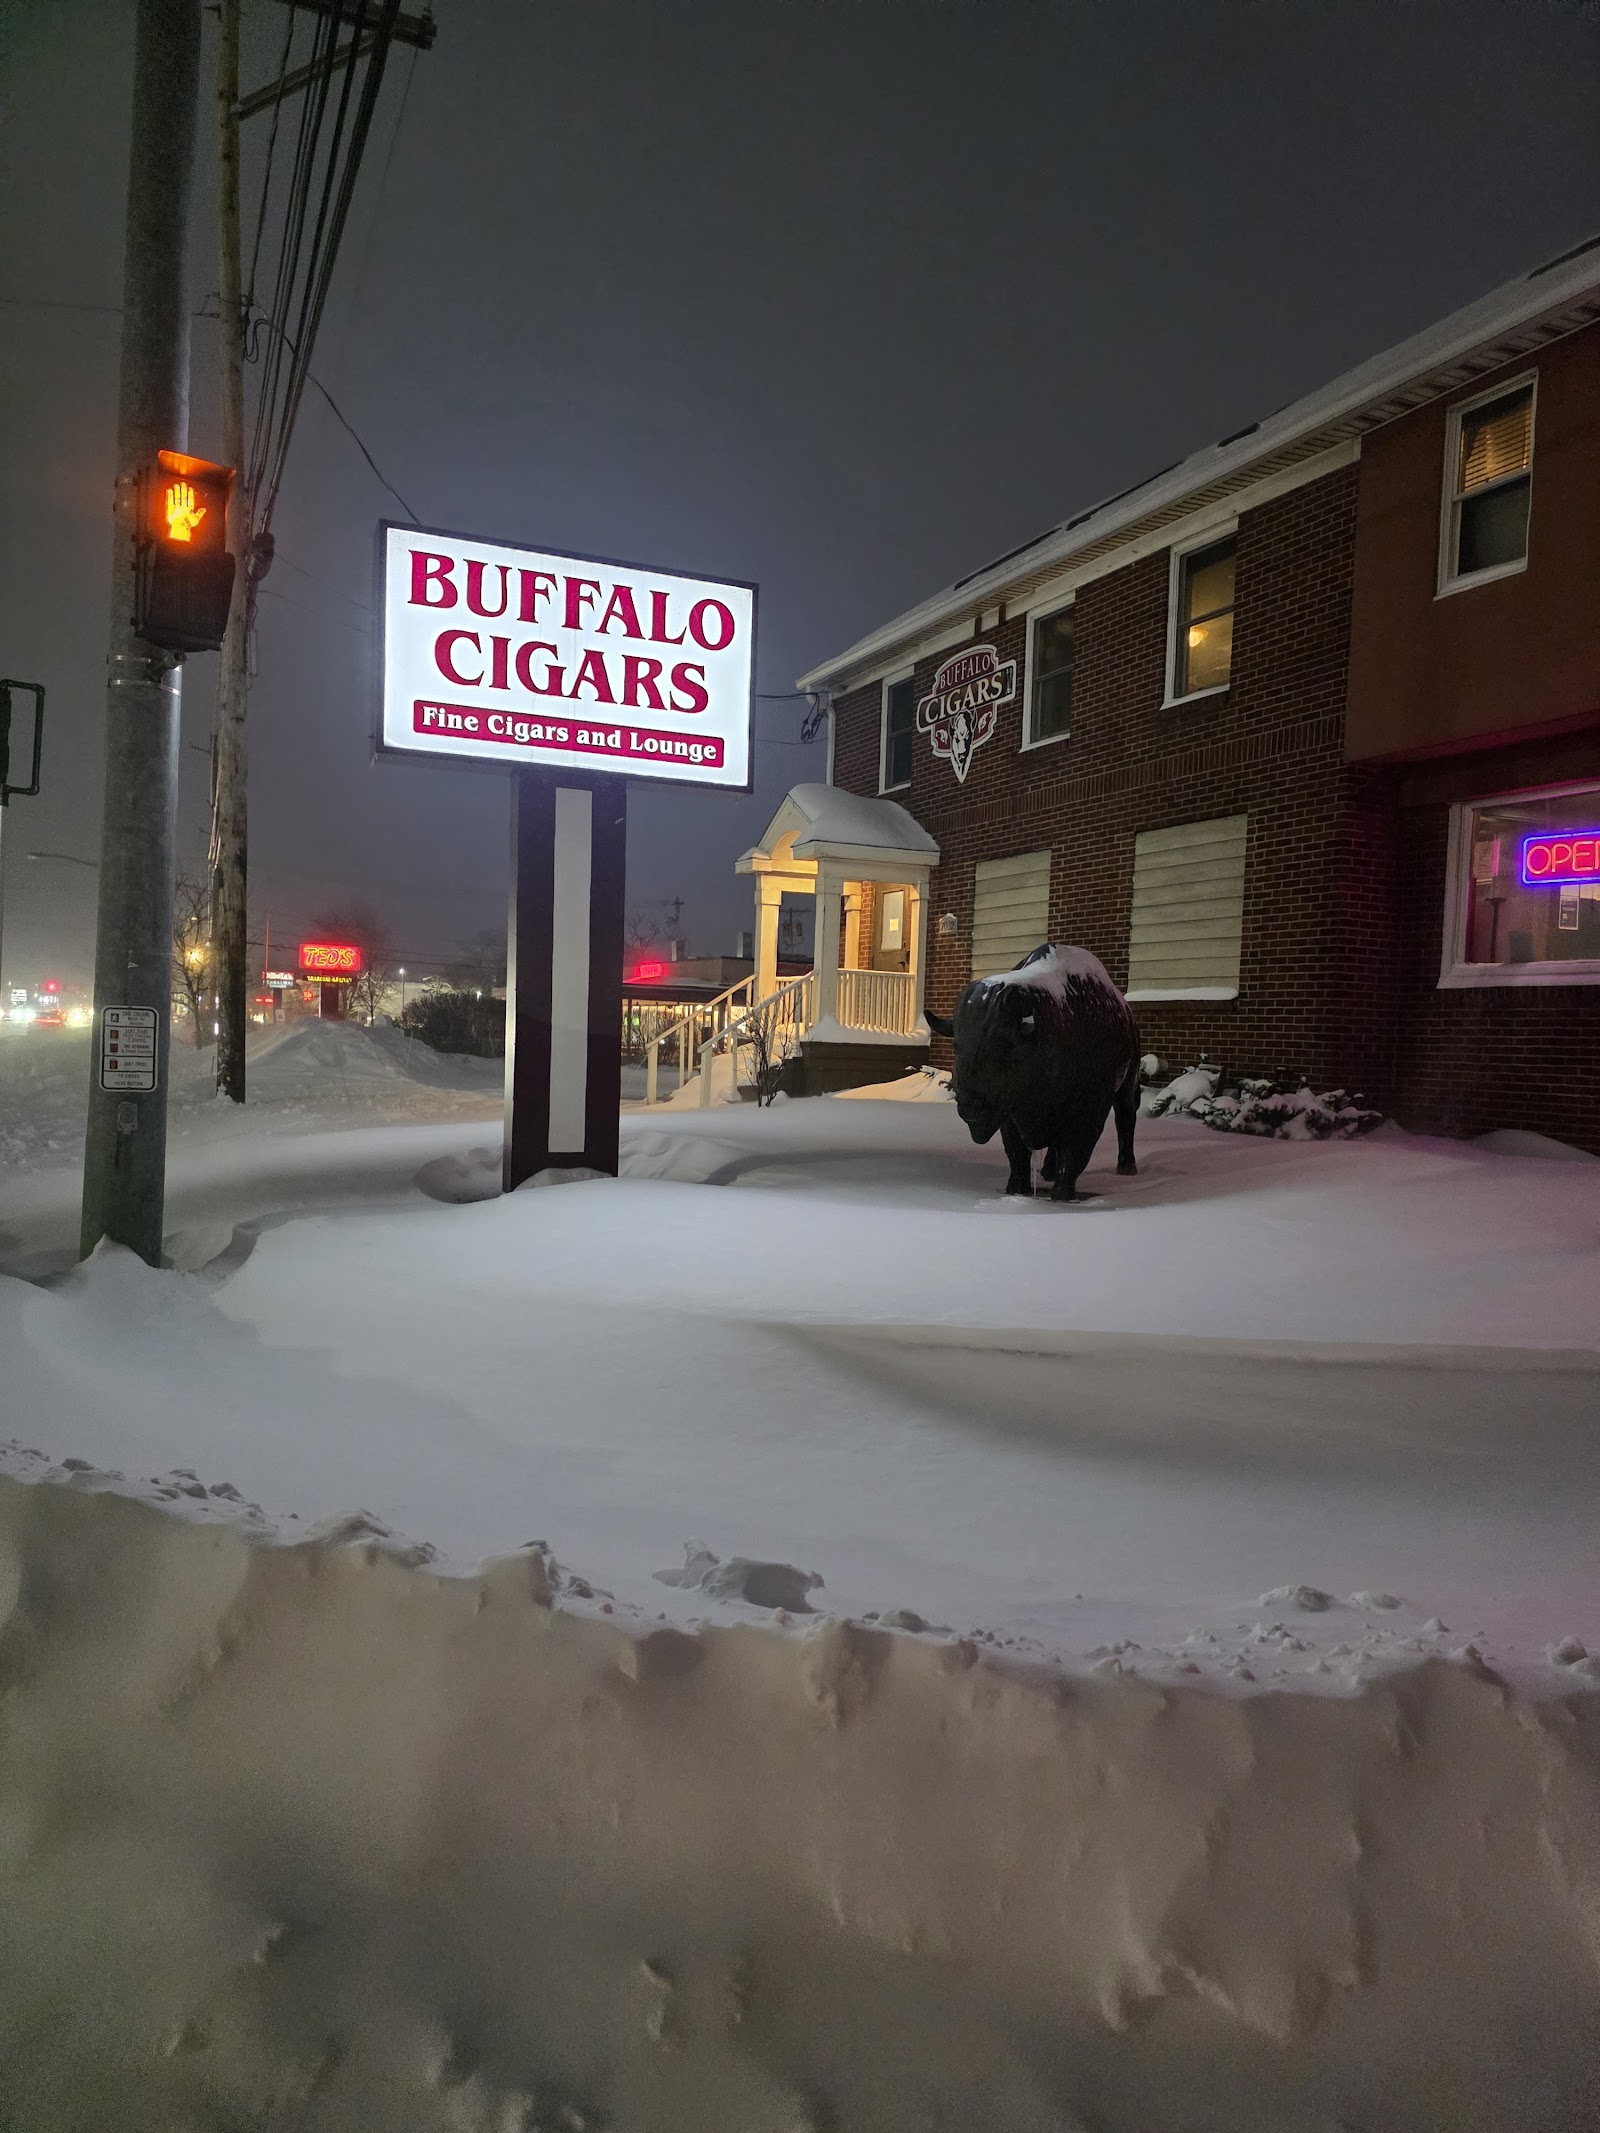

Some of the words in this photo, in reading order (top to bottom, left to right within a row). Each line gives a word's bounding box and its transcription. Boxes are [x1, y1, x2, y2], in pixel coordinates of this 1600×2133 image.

[407, 549, 735, 651] BUFFALO
[434, 629, 709, 714] CIGARS
[940, 654, 990, 689] BUFFALO
[925, 672, 1003, 723] CIGARS
[421, 705, 479, 732] Fine
[487, 714, 569, 743] Cigars
[577, 728, 621, 749] and
[629, 731, 717, 762] Lounge
[1526, 841, 1600, 875] OPE
[304, 947, 354, 966] TED'S
